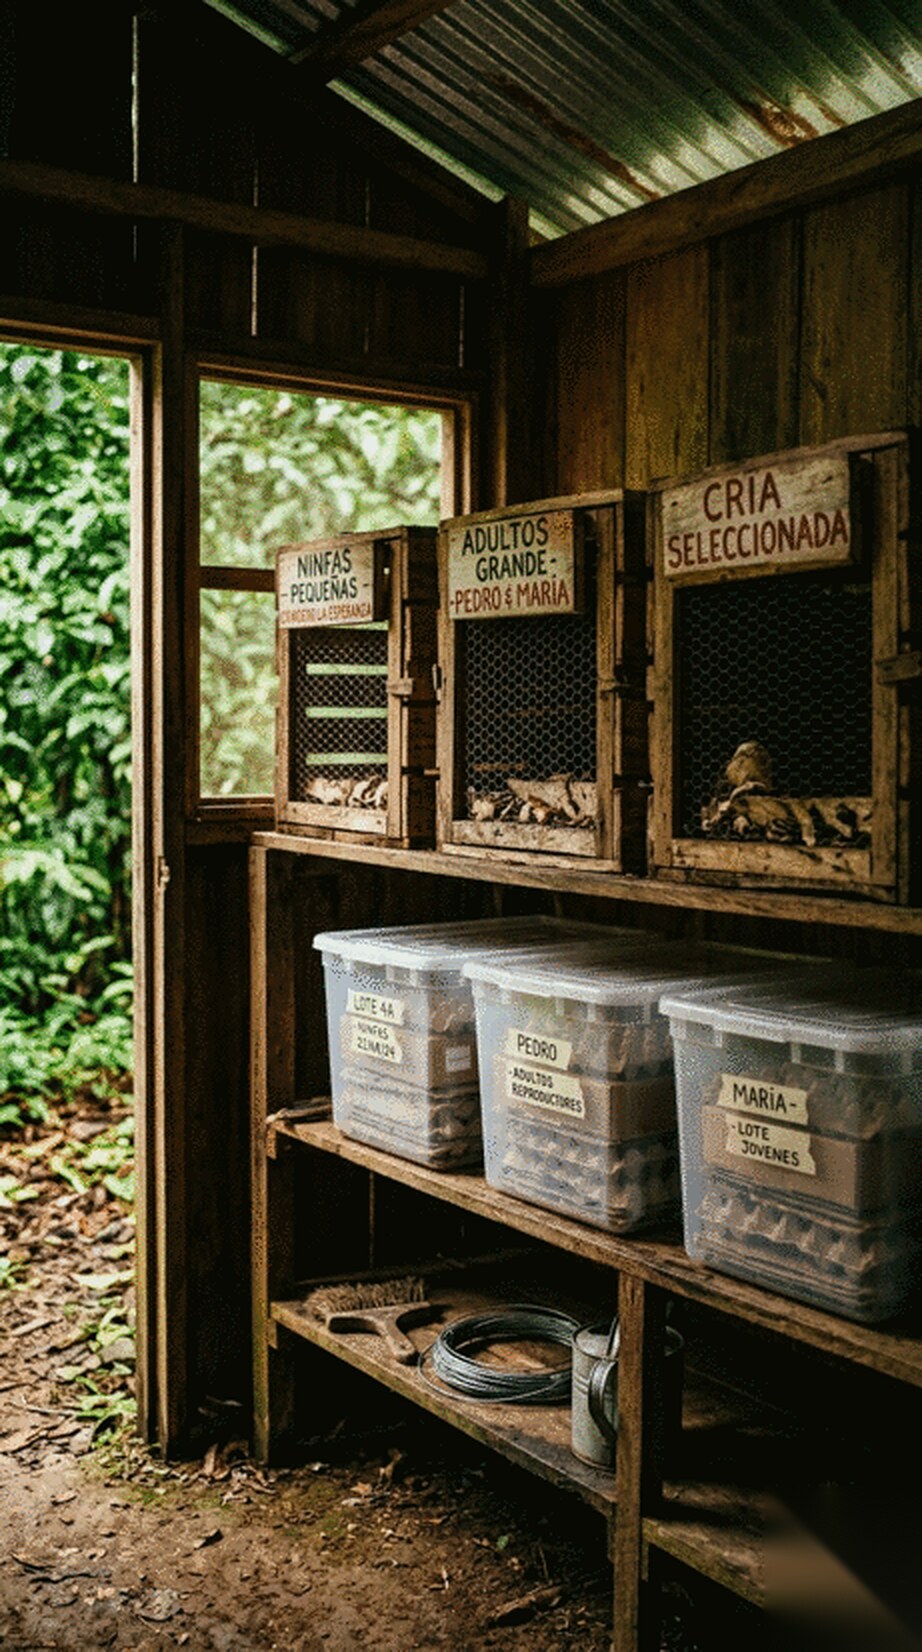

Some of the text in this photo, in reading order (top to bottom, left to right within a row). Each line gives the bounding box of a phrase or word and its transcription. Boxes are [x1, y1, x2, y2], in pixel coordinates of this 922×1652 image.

[704, 472, 781, 522] CRIA
[462, 517, 549, 556] ADULTOS
[668, 508, 848, 568] SELECCIONADA
[297, 547, 352, 578] NINFAS
[517, 574, 570, 607] MARÍA
[353, 994, 378, 1015] LOTE
[517, 1033, 557, 1061] PEDRO
[512, 1082, 582, 1113] REPRODUCTORES
[741, 1139, 799, 1167] JOVENES
